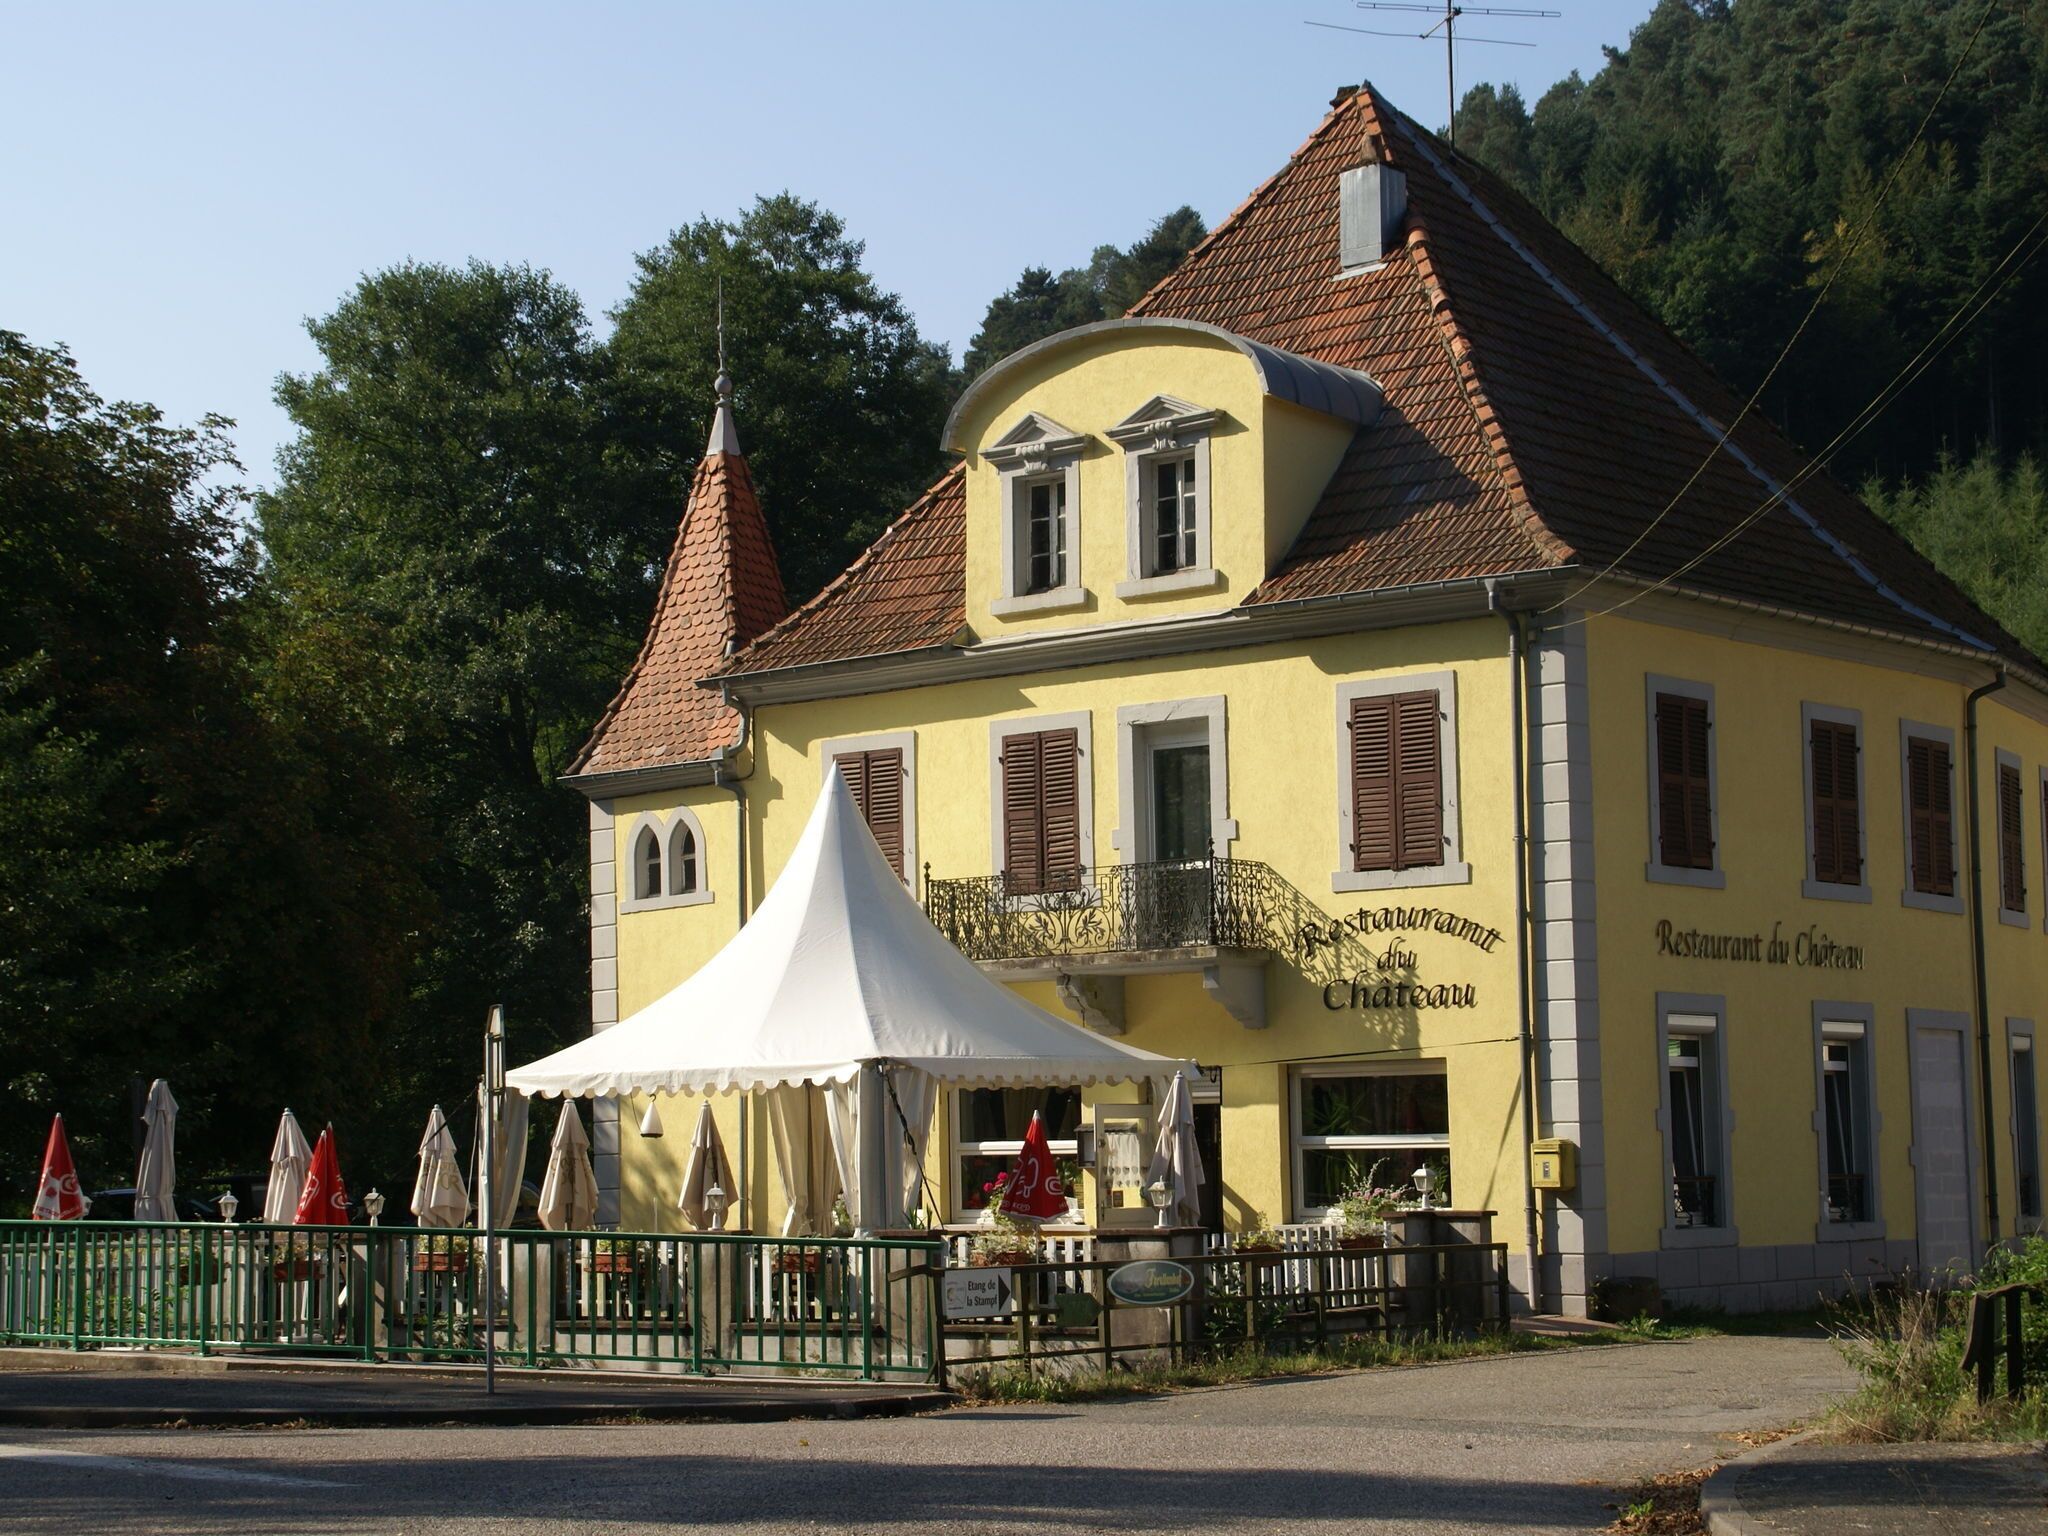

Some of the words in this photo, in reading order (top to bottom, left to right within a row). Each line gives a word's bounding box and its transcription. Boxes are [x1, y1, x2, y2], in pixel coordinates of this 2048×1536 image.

[1295, 906, 1506, 963] Restaurant
[1656, 919, 1763, 962] Restaurant
[1767, 921, 1790, 965] du
[1795, 924, 1865, 970] Château
[1377, 937, 1416, 970] du
[1323, 969, 1476, 1011] Château
[966, 1295, 973, 1307] la
[974, 1294, 998, 1309] Stampf
[967, 1280, 986, 1293] Etang
[987, 1280, 996, 1290] de
